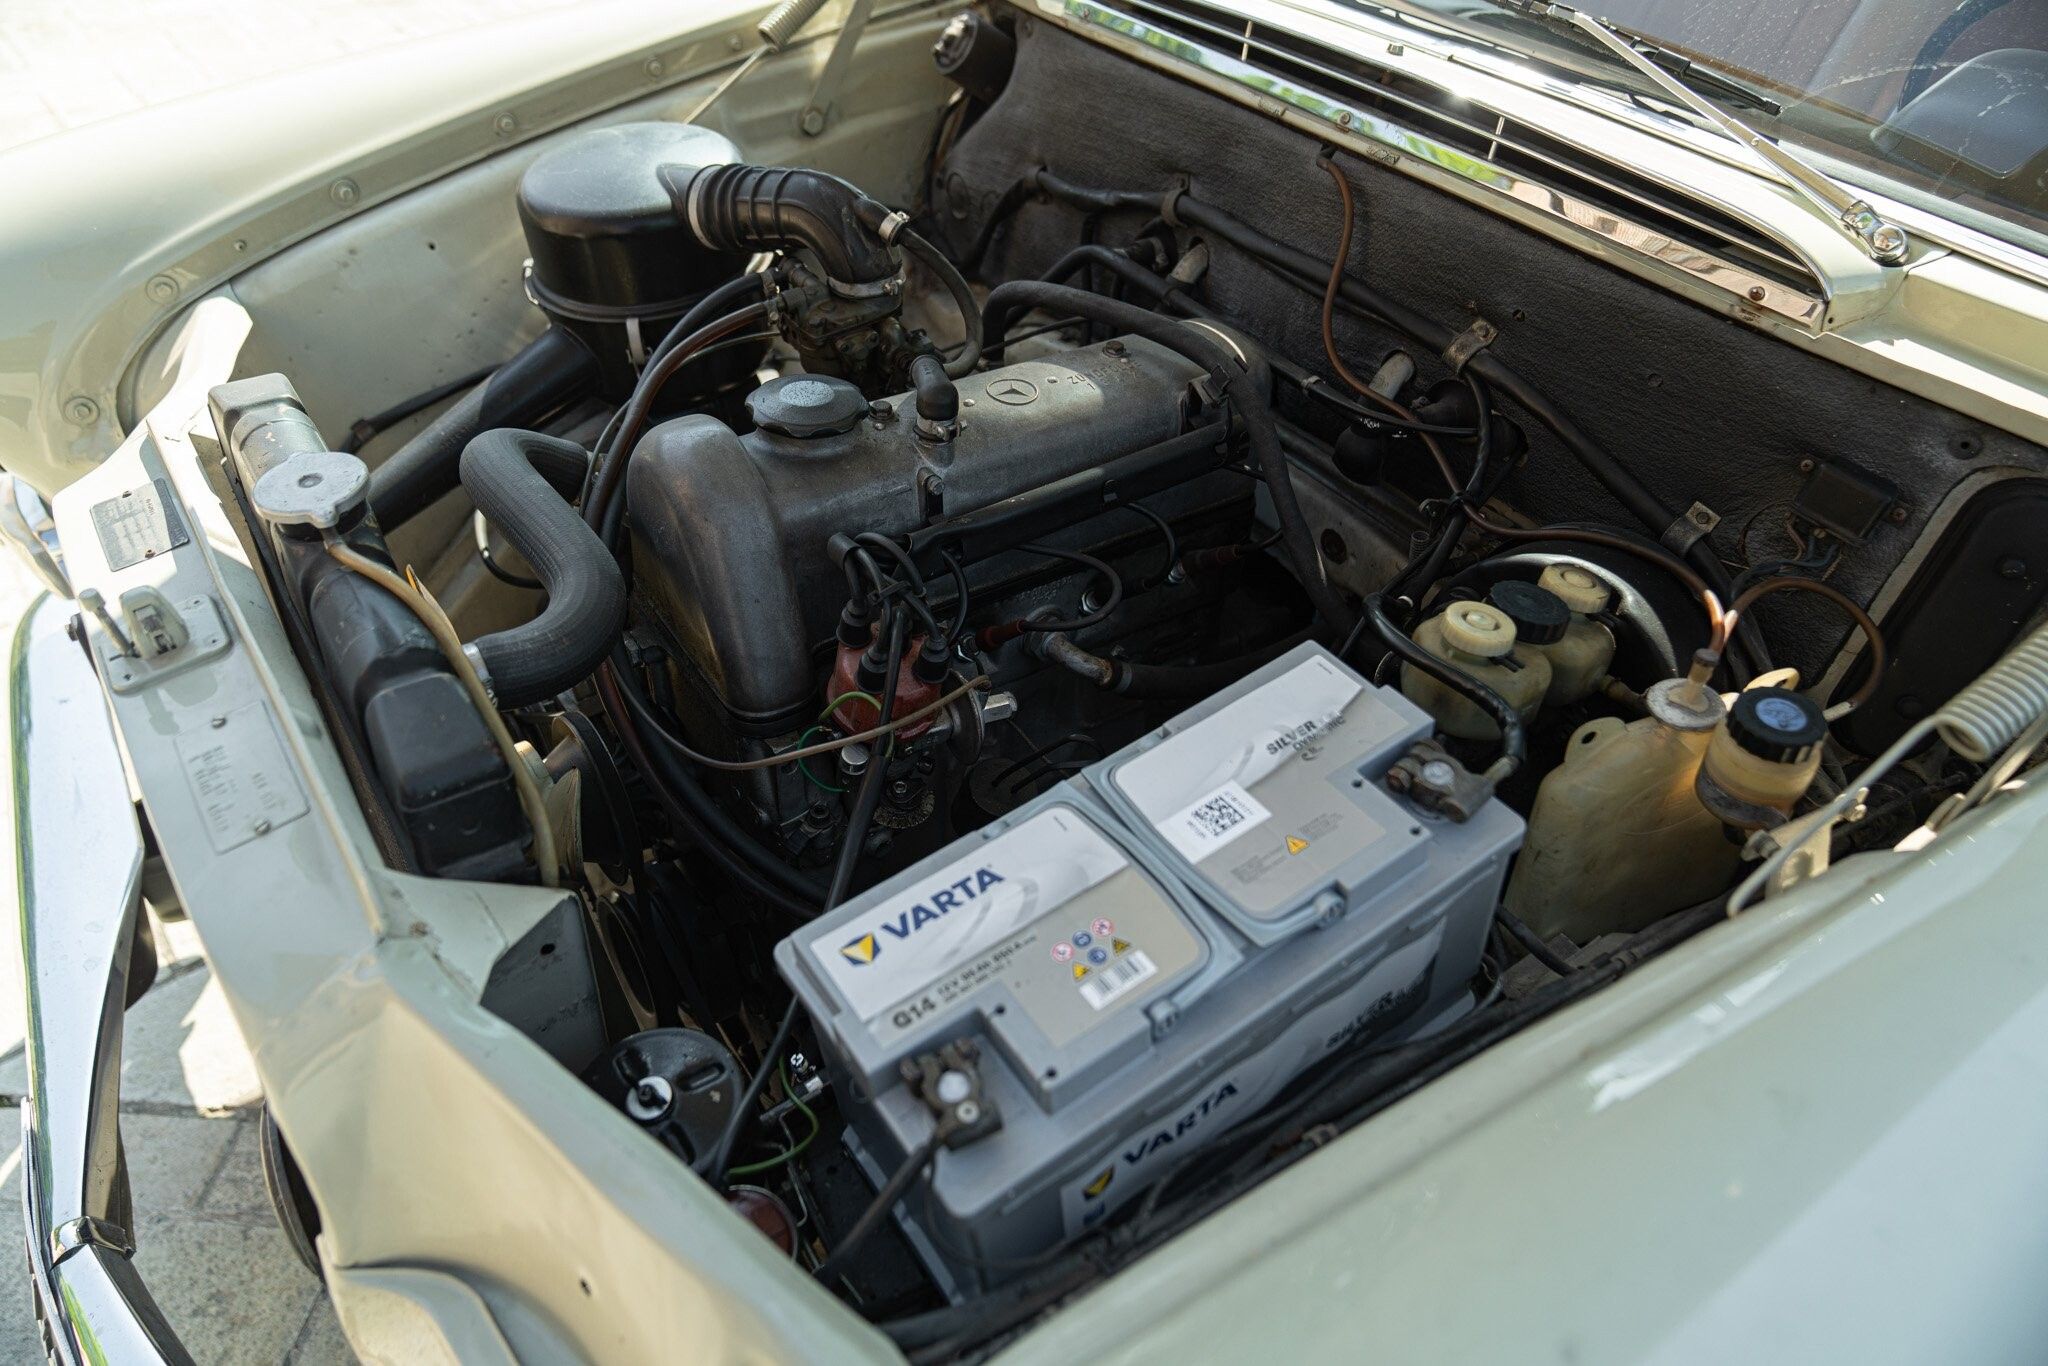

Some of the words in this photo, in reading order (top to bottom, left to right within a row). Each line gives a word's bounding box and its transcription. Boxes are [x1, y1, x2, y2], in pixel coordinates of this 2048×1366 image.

[1265, 720, 1318, 755] SILVER
[881, 867, 1005, 938] VARTA
[1123, 1083, 1238, 1164] VARTA
